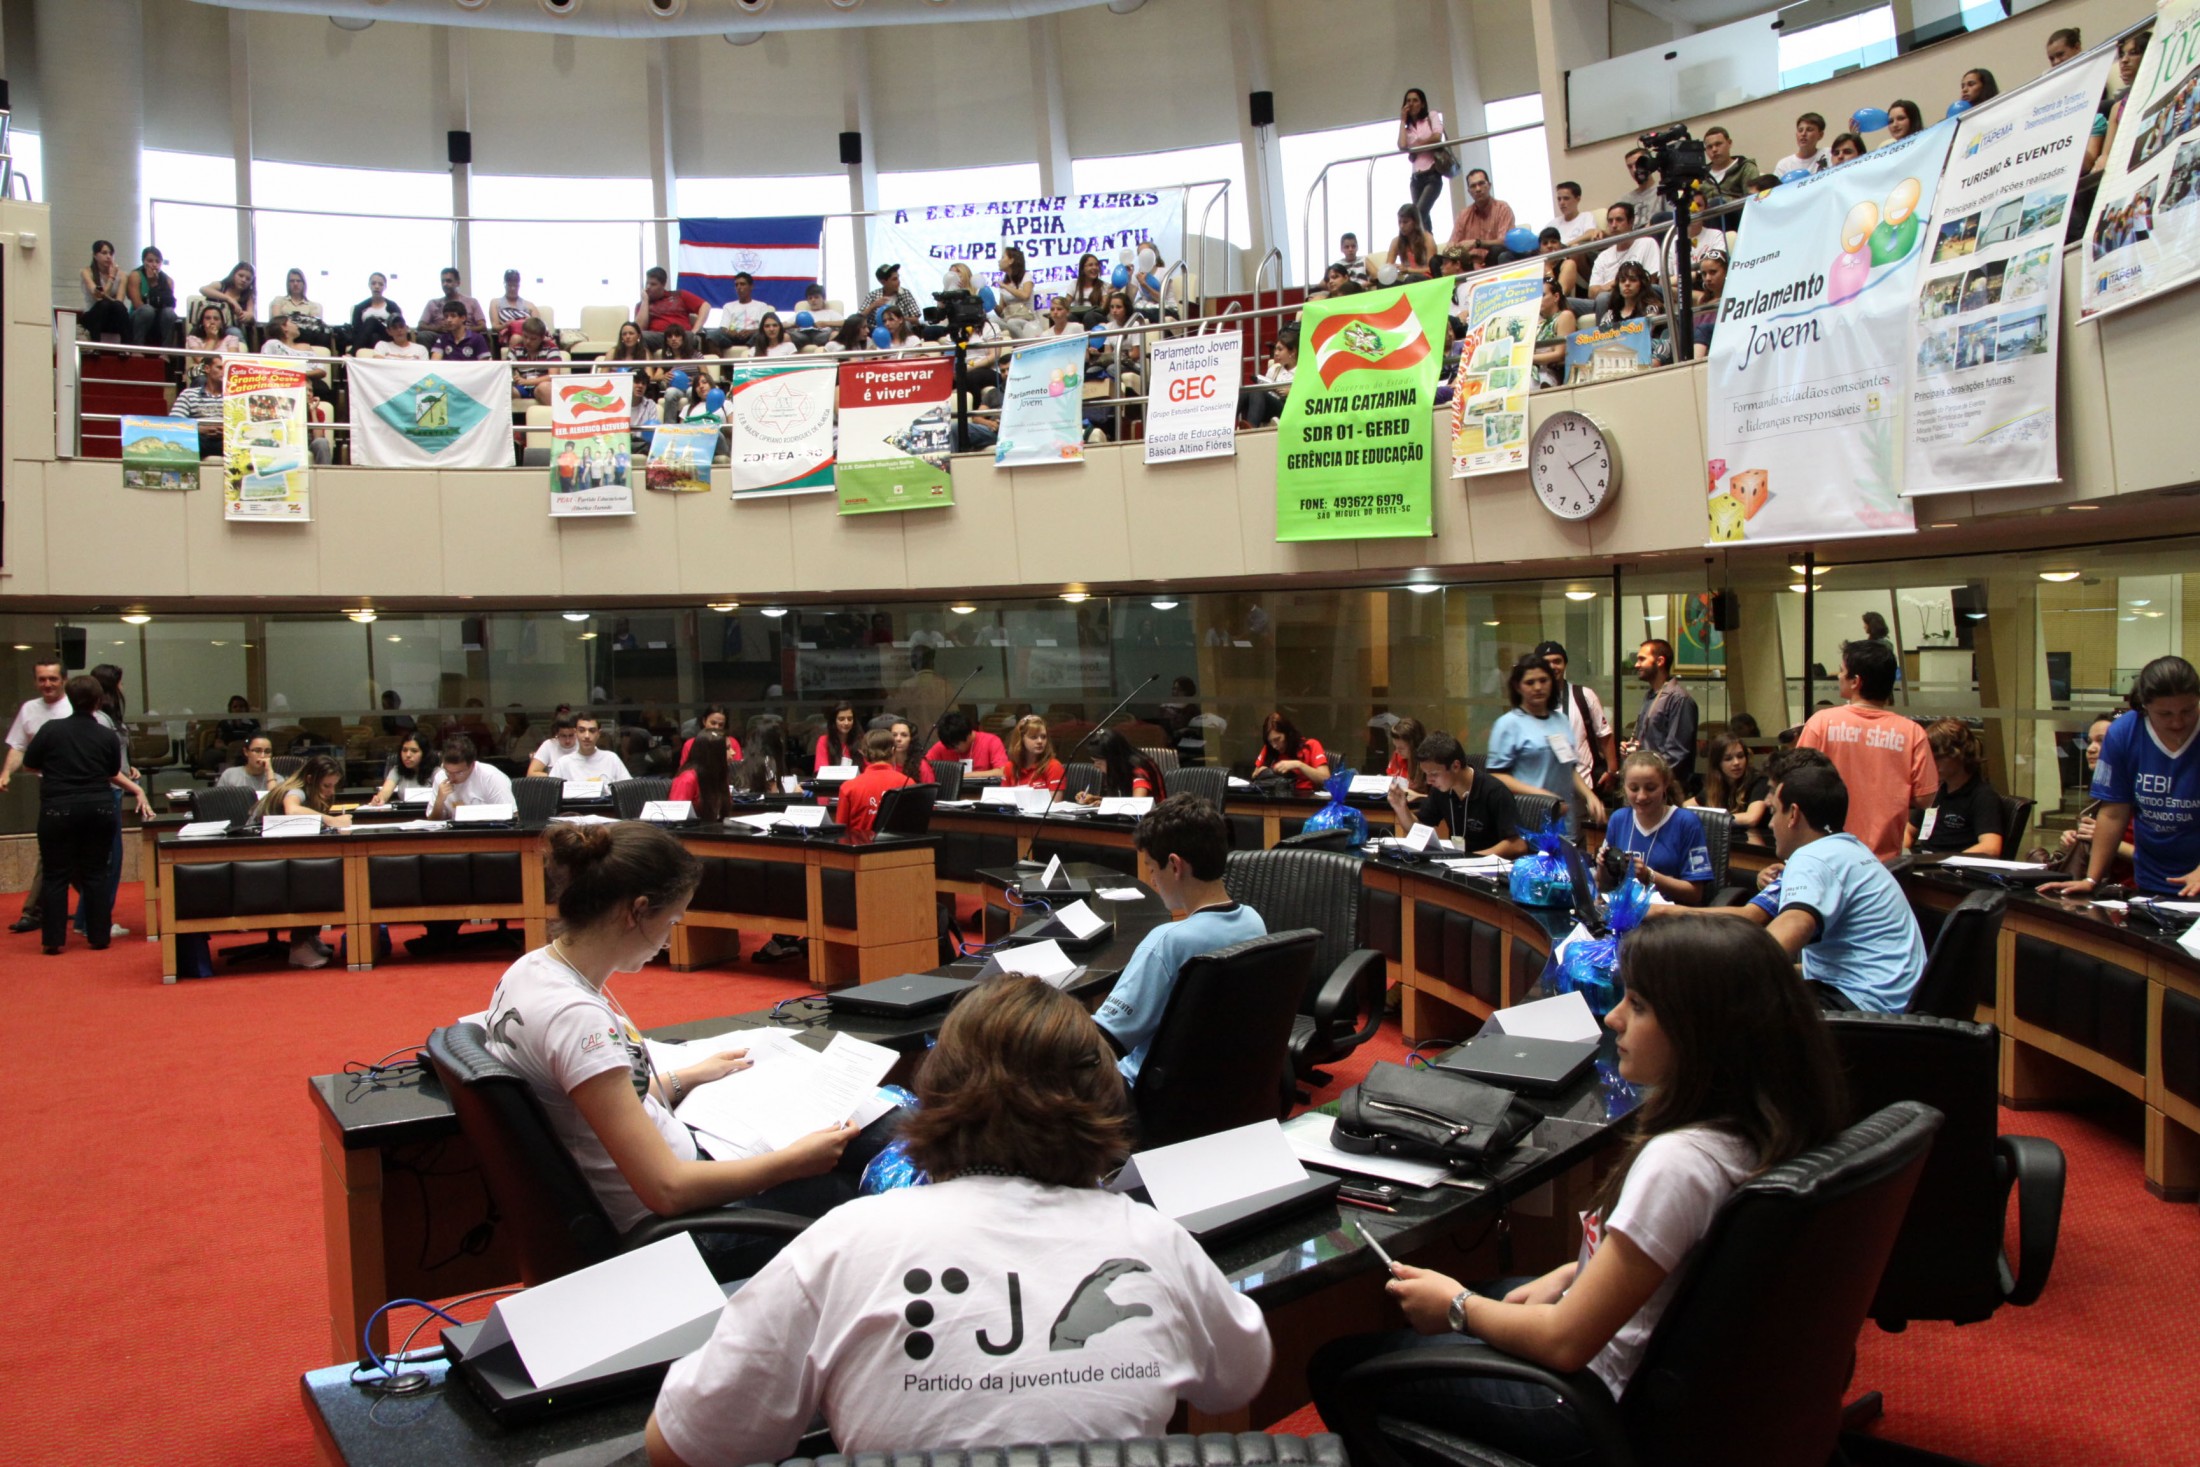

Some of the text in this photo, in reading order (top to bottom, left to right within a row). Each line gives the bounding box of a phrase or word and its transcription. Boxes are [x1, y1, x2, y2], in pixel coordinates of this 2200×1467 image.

[1873, 151, 1888, 160] DO
[1961, 135, 2073, 189] TURISMO & EVENTOS
[2000, 180, 2024, 193] ações
[894, 209, 908, 224] A
[1078, 191, 1159, 209] FLORES
[1000, 215, 1066, 236] APOIA
[929, 242, 997, 260] GRUPO
[1731, 250, 1780, 270] Programa
[1720, 272, 1824, 323] Parlamento
[1153, 340, 1239, 361] Parlamento Jovem
[1738, 318, 1821, 371] Jovem
[1168, 355, 1219, 373] Anitápolis
[230, 374, 300, 385] Grande Oeste
[855, 369, 934, 384] “Preservar
[863, 385, 921, 402] é viver”
[1008, 388, 1048, 399] Parlamento
[1168, 374, 1217, 402] GEC
[1732, 374, 1891, 414] Formando cidadãos conscientes
[1017, 399, 1043, 411] Jovem
[1304, 388, 1417, 416] SANTA CATARINA
[1170, 407, 1199, 416] Estudantil
[1738, 403, 1861, 434] e lideranças responsáveis
[744, 424, 760, 438] MAJOR
[758, 434, 783, 444] CIPRIANO
[783, 430, 812, 444] RODRIGUES
[811, 425, 819, 434] DE
[1303, 425, 1333, 443] SDR
[1336, 423, 1353, 440] 01
[1366, 418, 1410, 438] GERED
[1563, 421, 1575, 431] 12
[1581, 427, 1587, 436] 1
[1148, 426, 1232, 444] Escola de Educação
[1551, 430, 1560, 440] 11
[1148, 446, 1176, 458] Básica
[1179, 443, 1204, 454] Altino
[1542, 444, 1555, 455] 10
[1593, 440, 1601, 450] 2
[1287, 441, 1424, 470] GERÊNCIA DE EDUCAÇÃO
[1600, 459, 1608, 468] 3
[1540, 464, 1547, 474] 9
[1546, 483, 1554, 493] 8
[1597, 479, 1605, 488] 4
[1299, 493, 1404, 510] FONE: 493622 6979
[1559, 496, 1567, 506] 7
[1573, 501, 1581, 511] 6
[1588, 494, 1595, 504] 5
[1316, 509, 1331, 520] SÃO
[1335, 508, 1361, 518] MIGUEL
[1363, 507, 1373, 516] DO
[1376, 506, 1397, 515] OESTE
[1828, 719, 1905, 752] inter state
[2135, 772, 2172, 794] PEBI
[2176, 812, 2193, 822] SUA
[581, 1032, 601, 1049] CAP
[904, 1361, 1161, 1394] Partido da juventude cidadã
